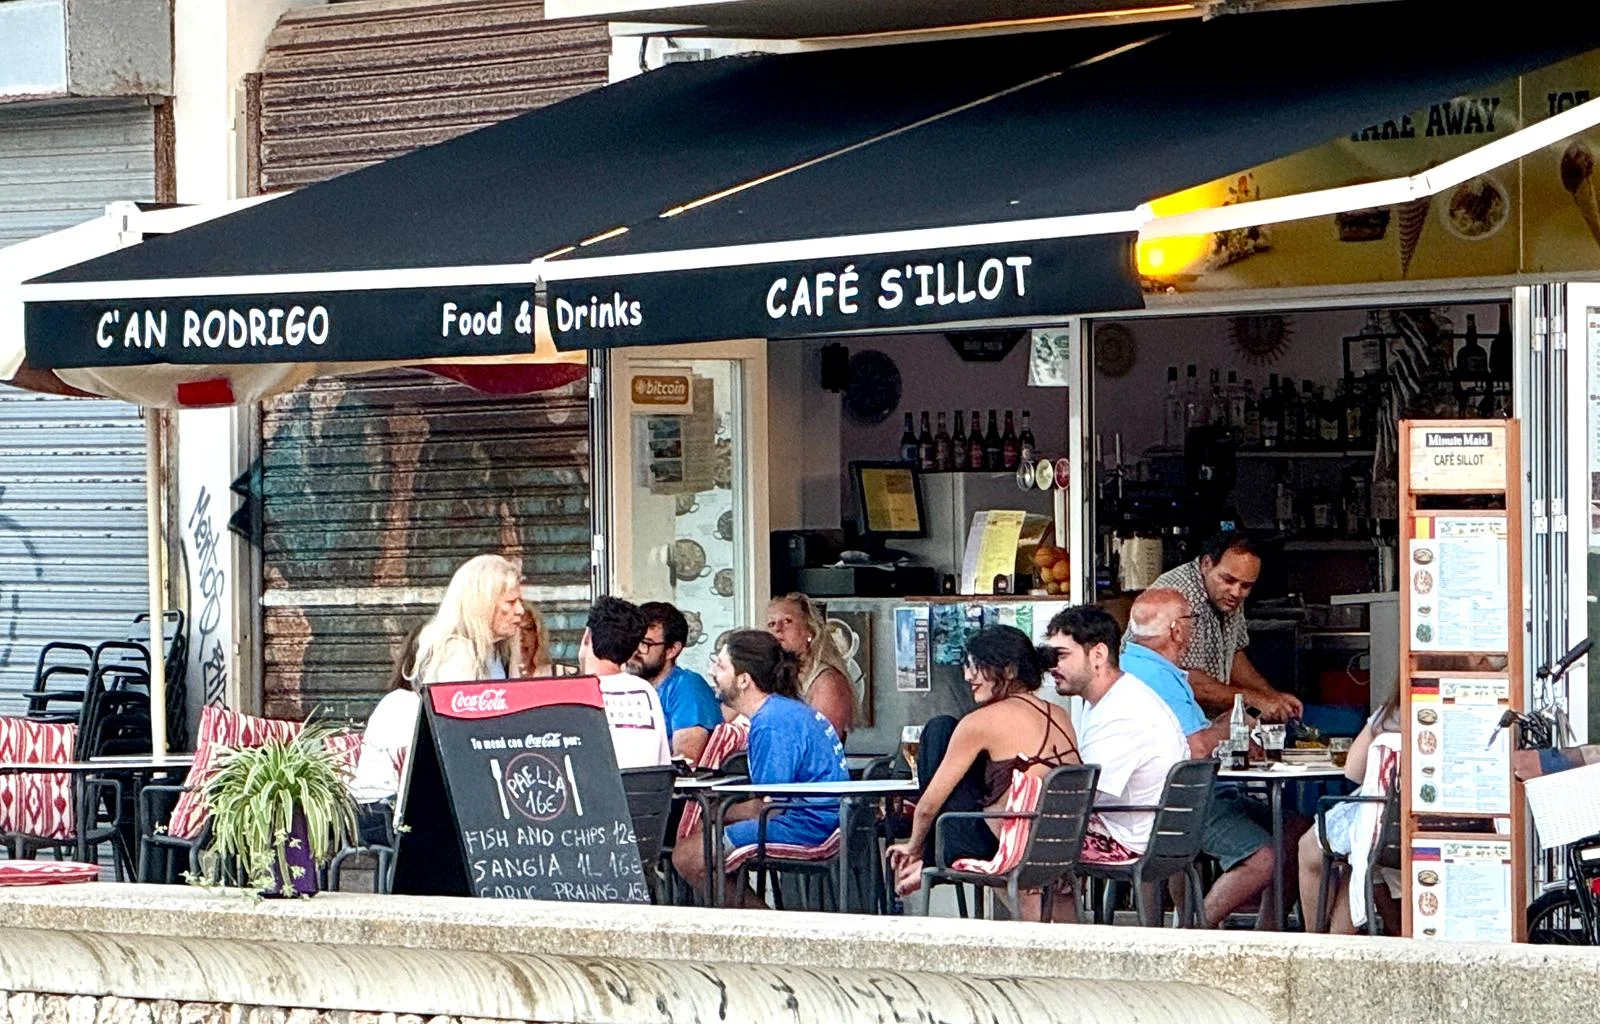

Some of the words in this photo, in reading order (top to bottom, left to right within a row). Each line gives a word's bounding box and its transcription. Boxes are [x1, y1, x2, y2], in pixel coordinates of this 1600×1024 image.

[1425, 98, 1500, 136] AWAY
[766, 264, 859, 319] CAFÉ
[878, 256, 1033, 310] S'ILLOT
[96, 309, 168, 349] C'AN
[183, 306, 330, 348] RODRIGO
[442, 302, 502, 337] Food
[515, 302, 533, 335] &
[557, 290, 643, 331] Drinks
[646, 380, 686, 395] bitcoin
[1428, 433, 1463, 446] Minute
[1463, 433, 1489, 446] Maid
[1434, 451, 1455, 466] CAFÉ
[1456, 454, 1485, 466] SILLOT
[451, 688, 509, 713] Coca-Cola
[507, 739, 523, 749] con
[524, 732, 562, 749] Coca-Cola
[506, 765, 566, 799] PAELLA
[525, 790, 557, 815] 16€
[465, 828, 510, 854] FISH
[516, 825, 554, 846] AND
[561, 826, 606, 848] CHIPS
[612, 820, 638, 846] 12€
[473, 852, 563, 884] SANGIA
[608, 850, 643, 879] 16€
